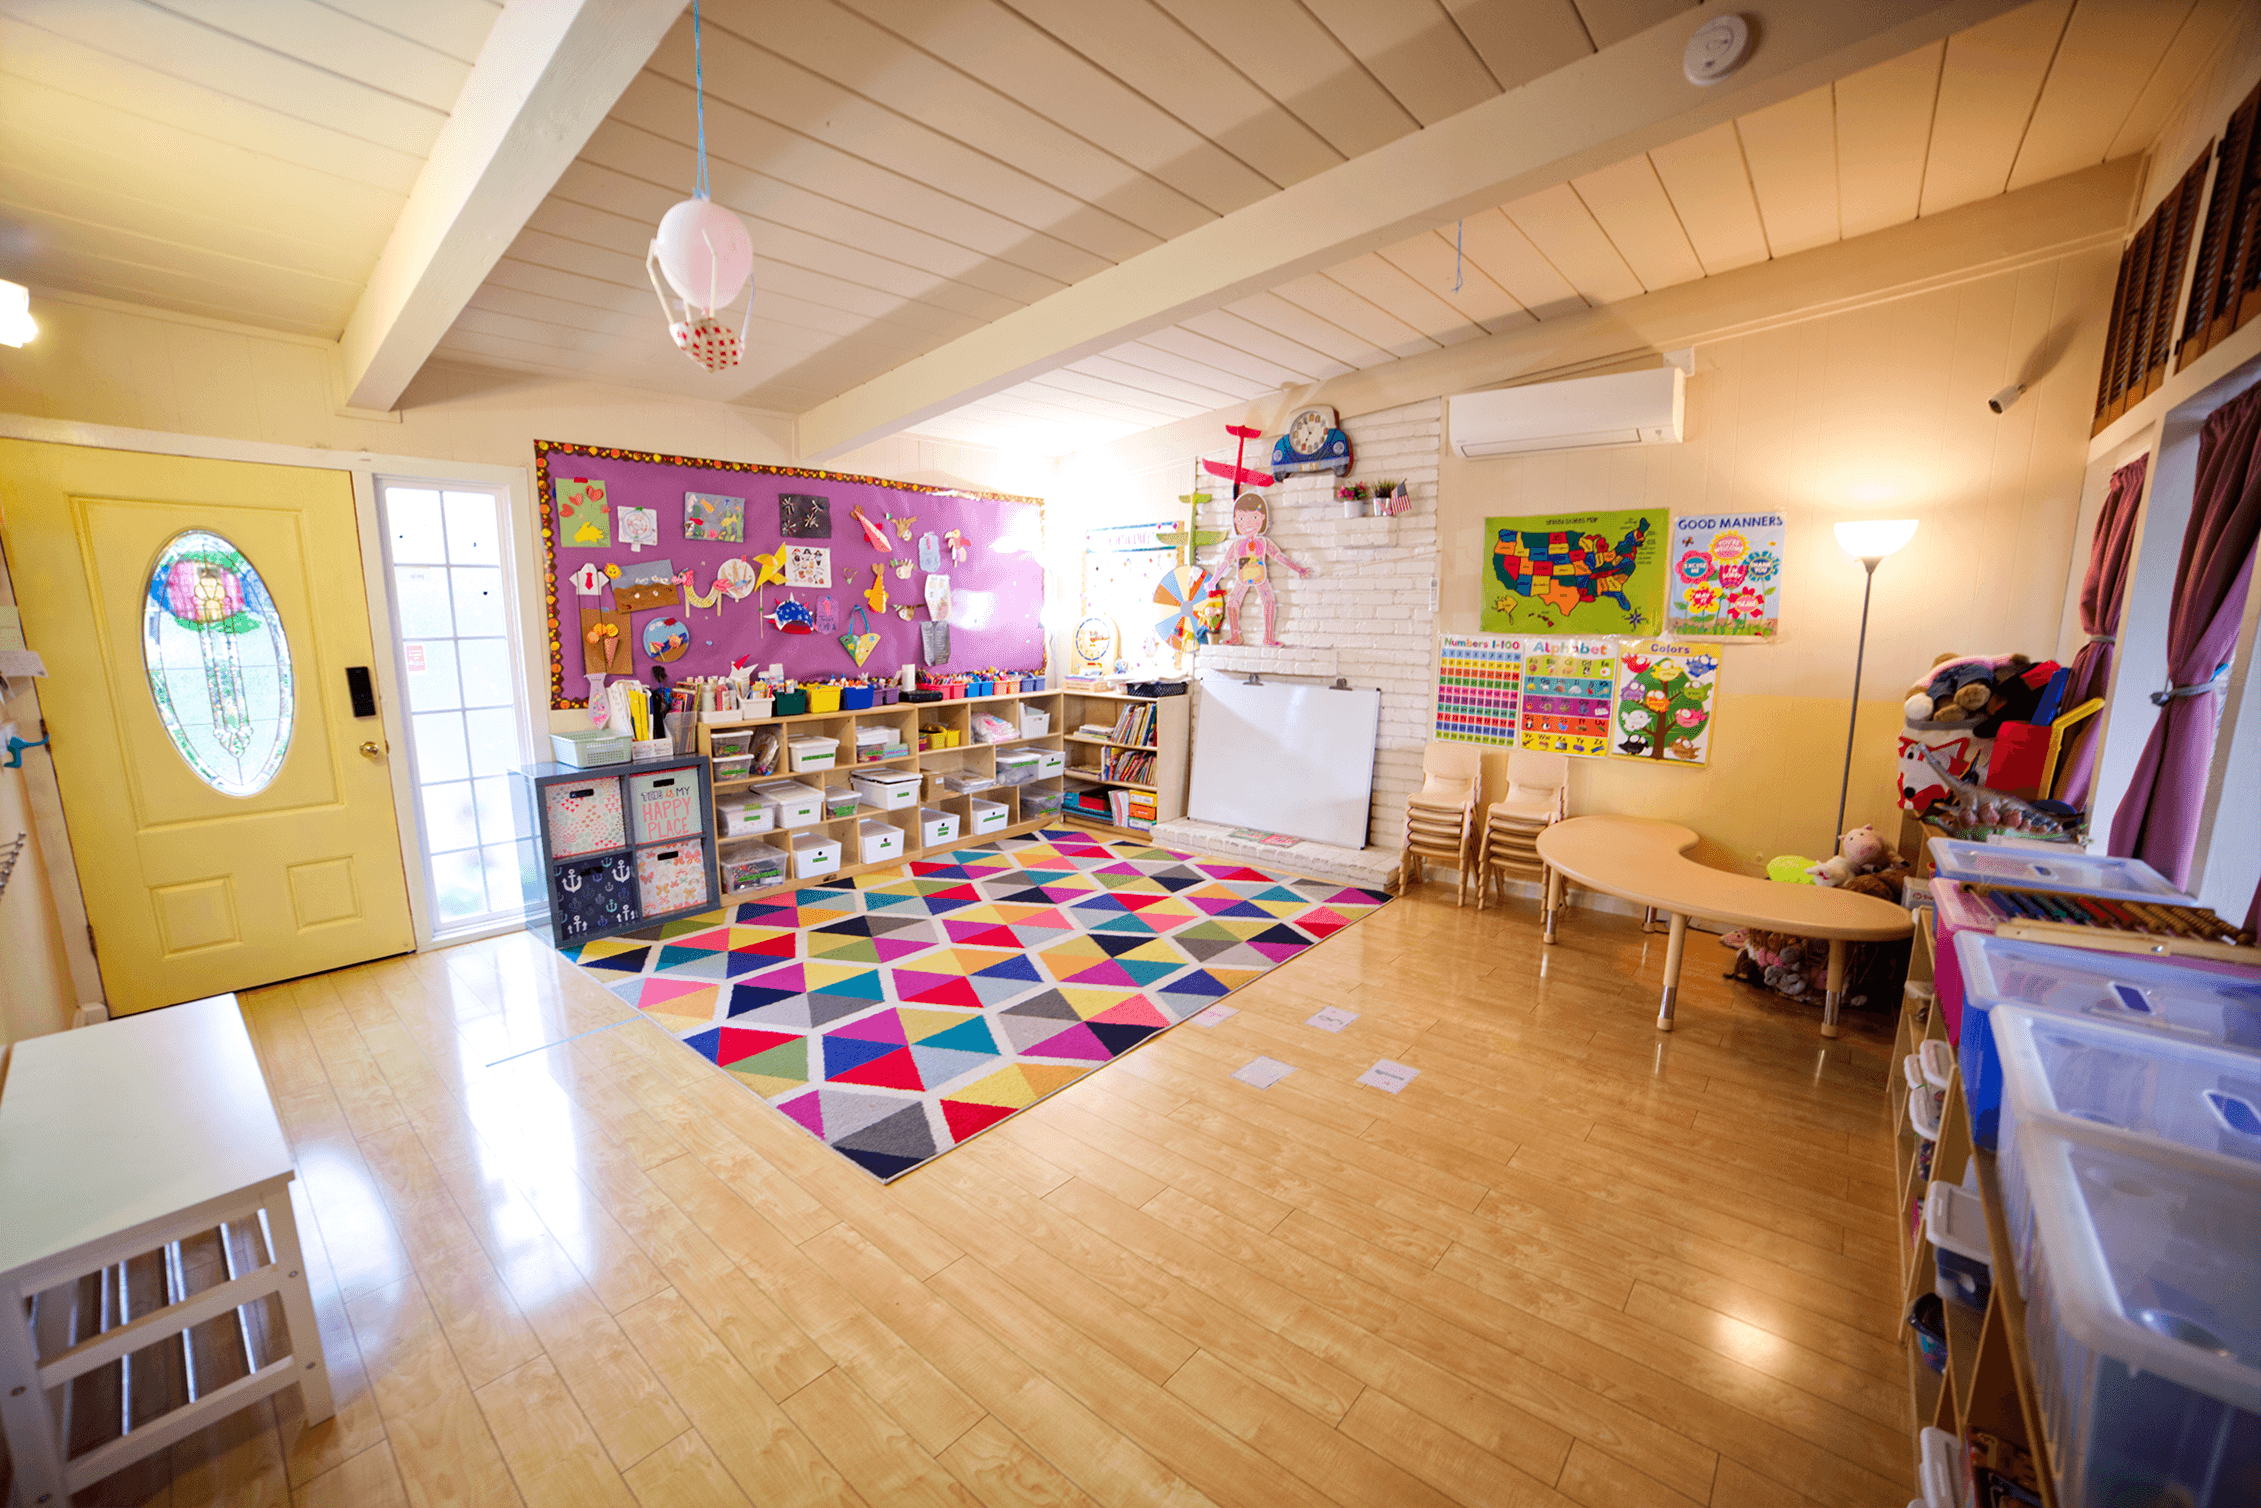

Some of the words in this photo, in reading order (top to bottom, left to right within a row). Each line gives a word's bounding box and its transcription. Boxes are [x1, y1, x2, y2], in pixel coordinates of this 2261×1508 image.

[1678, 519, 1716, 530] GOOD
[1719, 516, 1783, 529] MANNERS
[1713, 545, 1744, 553] WELCOME
[1444, 637, 1488, 649] Numbers
[1492, 640, 1520, 650] 1-100
[1533, 641, 1607, 656] Alphabet
[1650, 643, 1690, 654] Colors
[675, 786, 691, 797] MY
[642, 796, 692, 822] HAPPY
[647, 816, 690, 840] PLACE
